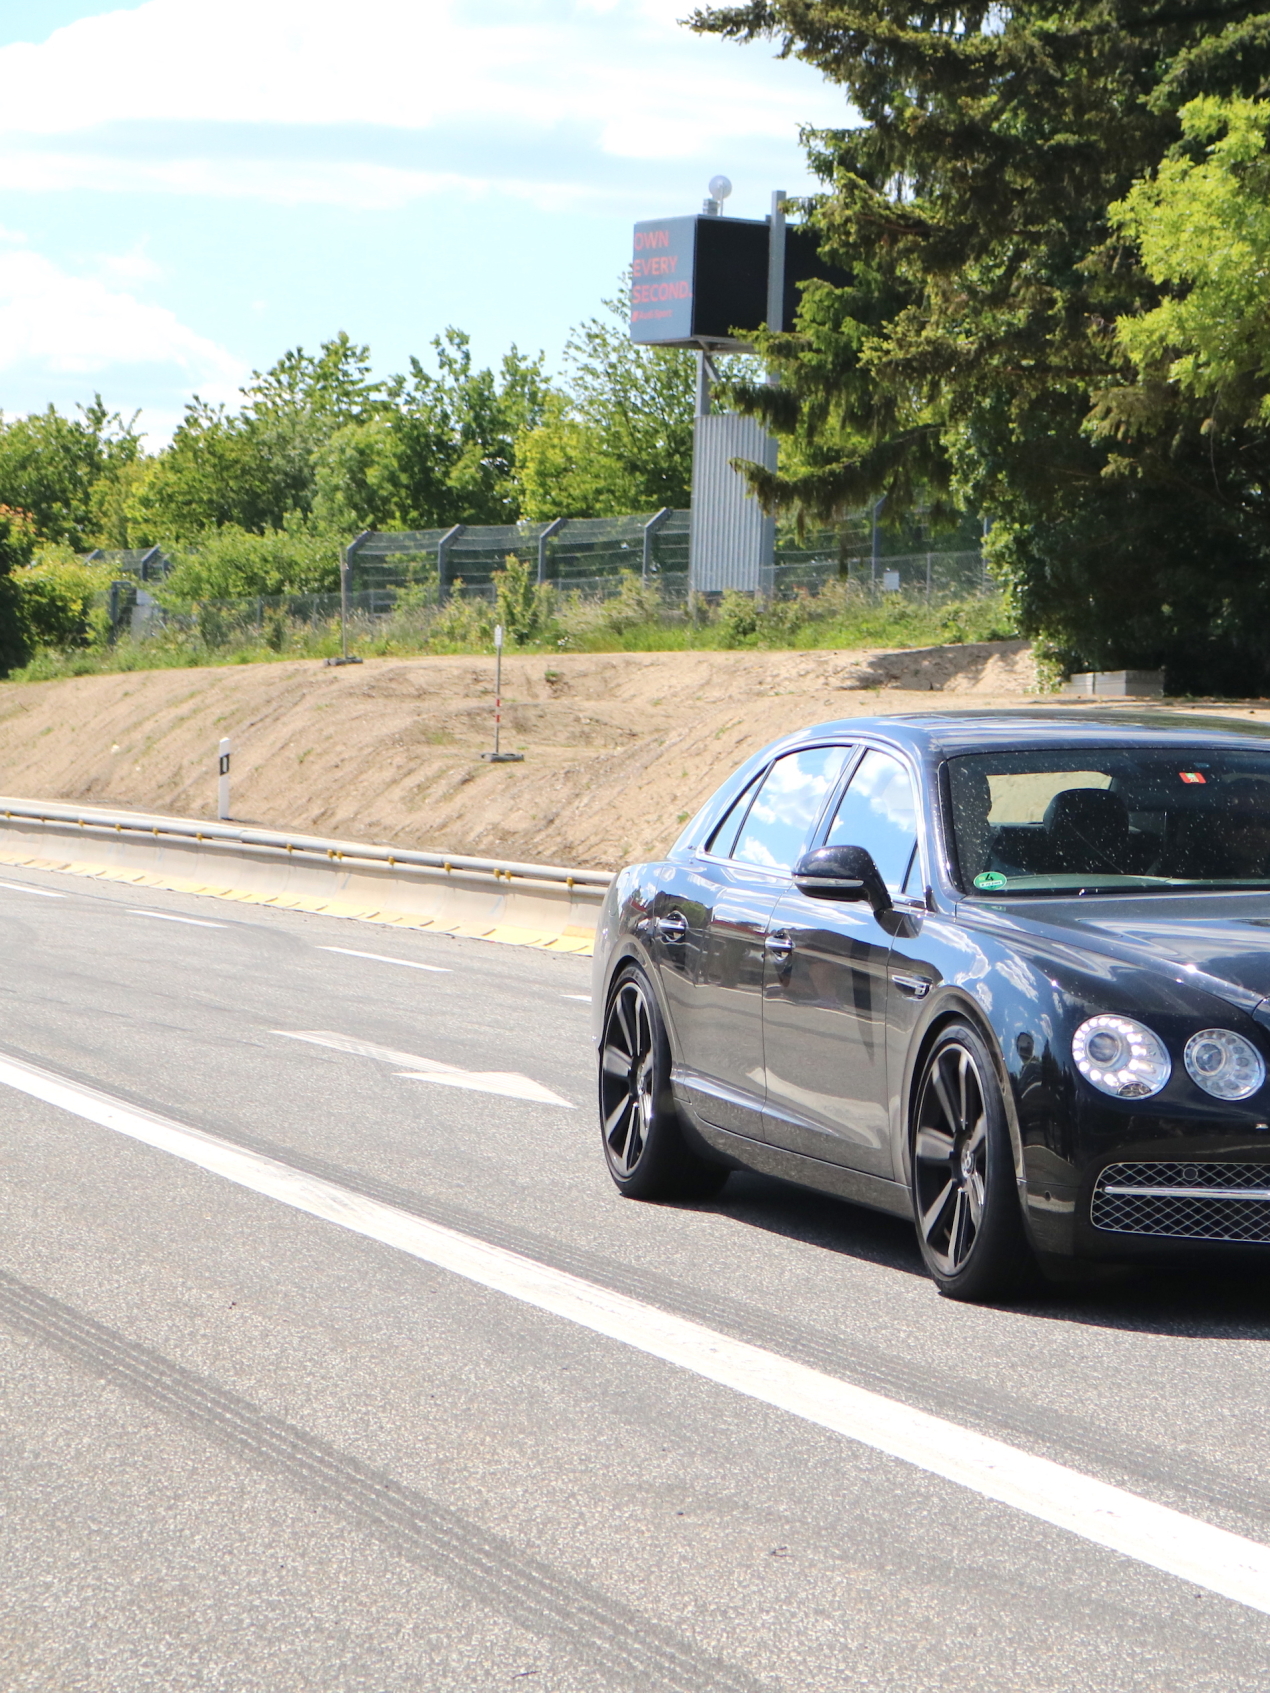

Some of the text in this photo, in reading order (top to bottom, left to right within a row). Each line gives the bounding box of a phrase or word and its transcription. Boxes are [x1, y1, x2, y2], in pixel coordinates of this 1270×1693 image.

[634, 231, 669, 250] OWN
[633, 256, 678, 277] EVERY
[631, 281, 693, 303] SECOND.
